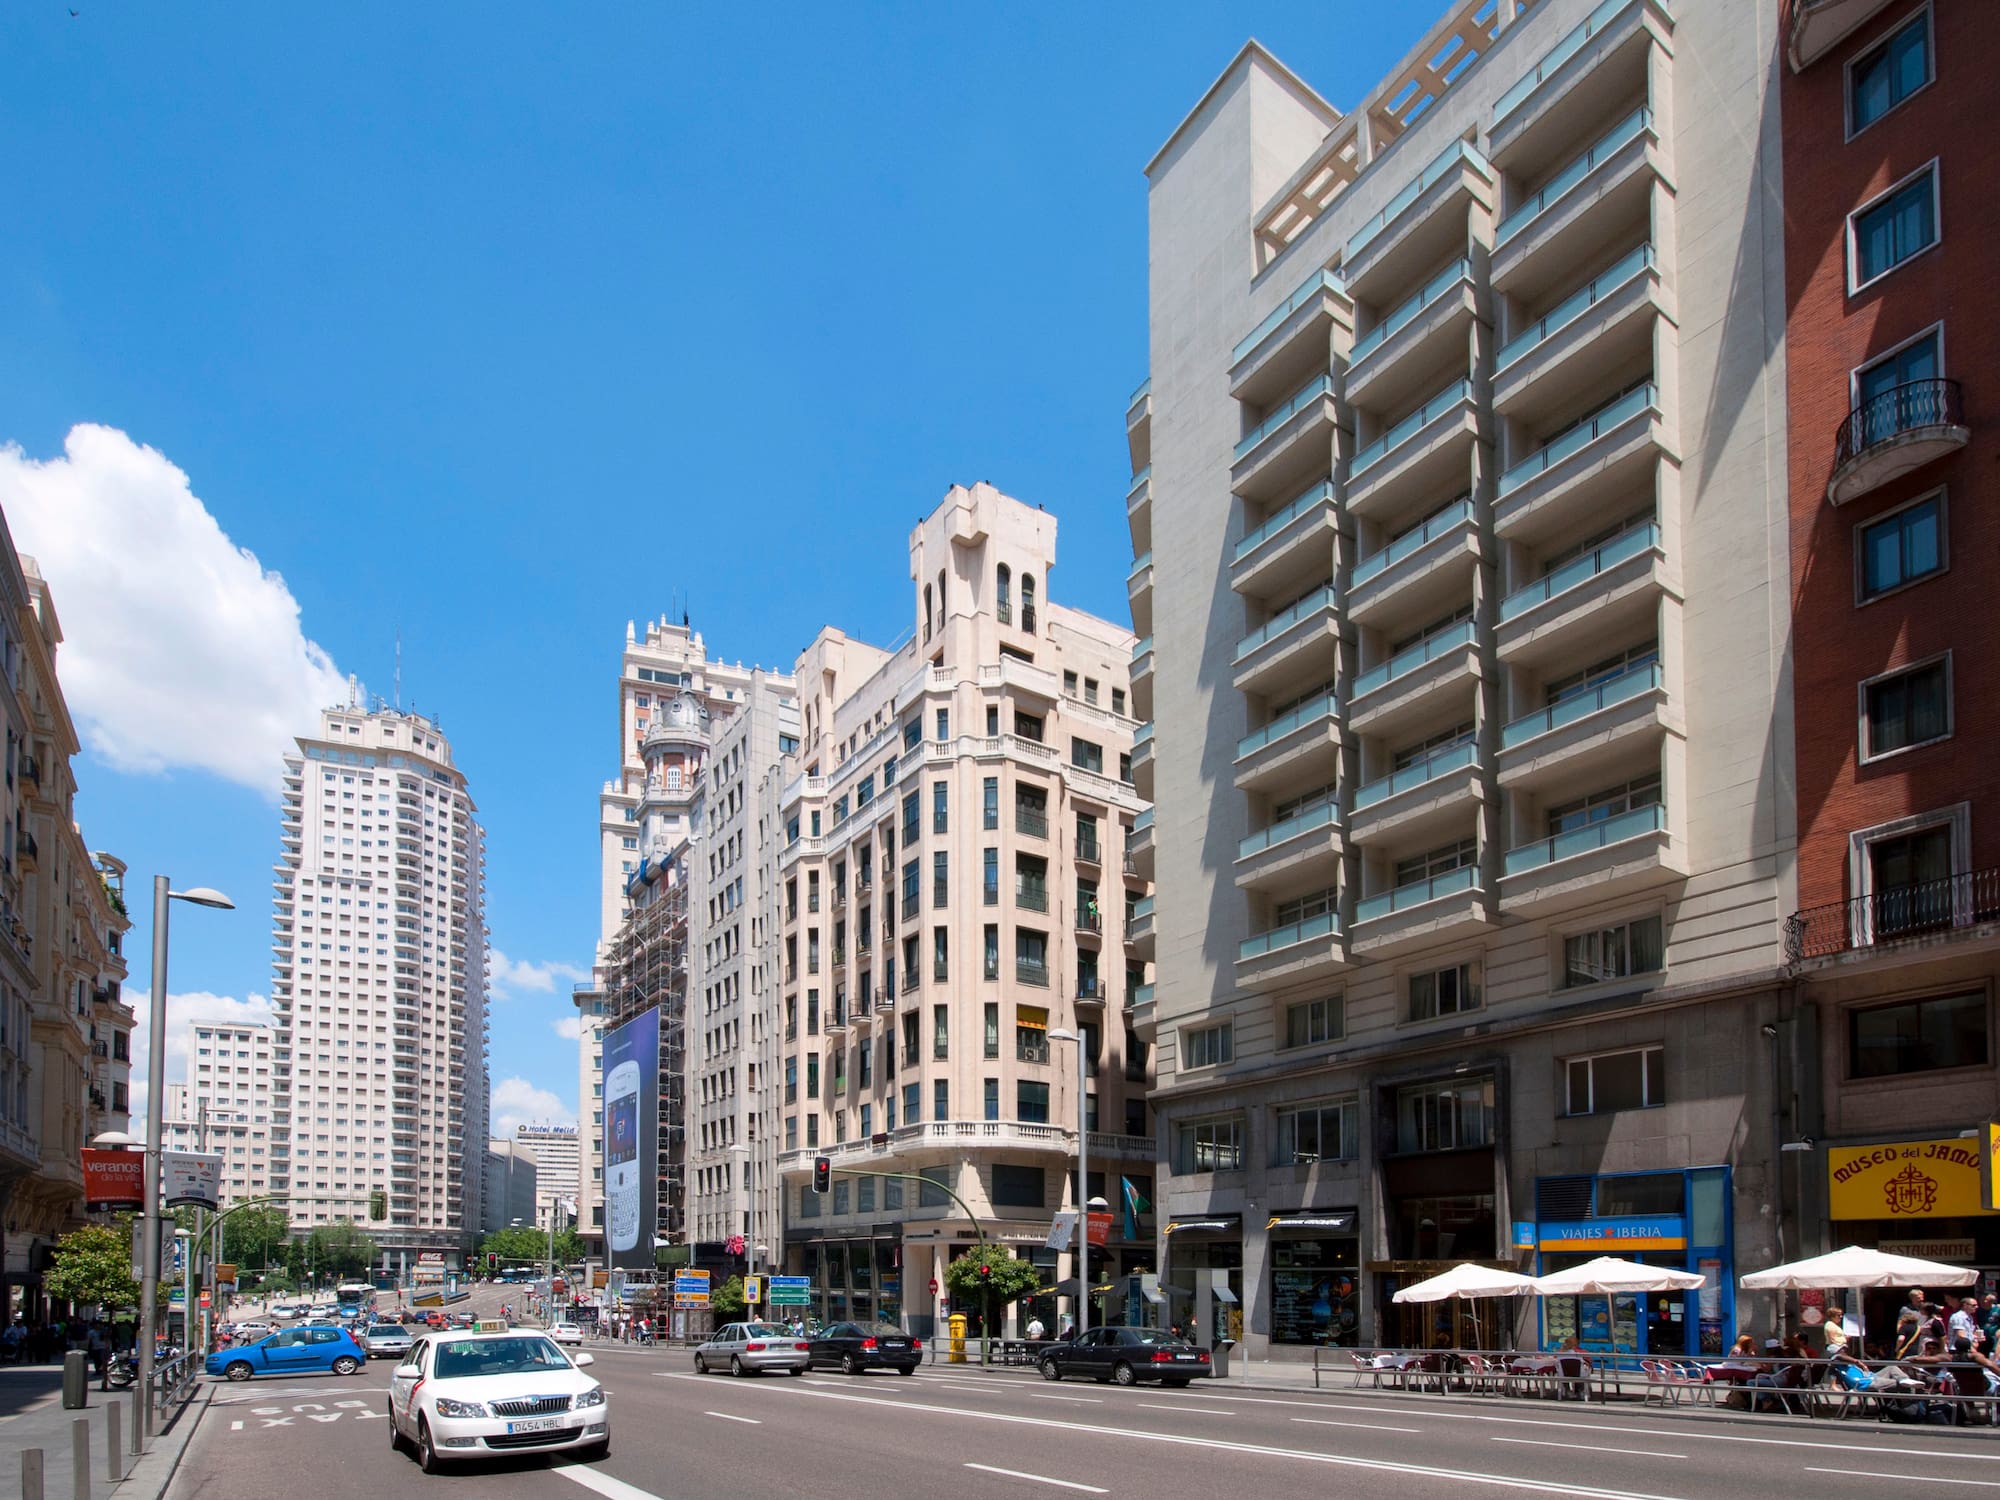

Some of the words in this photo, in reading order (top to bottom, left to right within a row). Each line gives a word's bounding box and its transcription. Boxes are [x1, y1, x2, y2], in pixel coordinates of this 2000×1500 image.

[528, 1125, 550, 1133] Hotel
[87, 1162, 141, 1173] veranos
[1833, 1148, 1897, 1184] MUSEO
[1901, 1148, 1920, 1158] del
[1924, 1144, 1981, 1171] JAMO
[101, 1172, 113, 1182] de
[115, 1172, 124, 1182] la
[1561, 1227, 1602, 1240] VIAJES
[1617, 1226, 1662, 1238] IBERIA
[1880, 1243, 1974, 1257] RESTAURANTE
[515, 1421, 540, 1432] 0454
[543, 1419, 561, 1430] HBL
